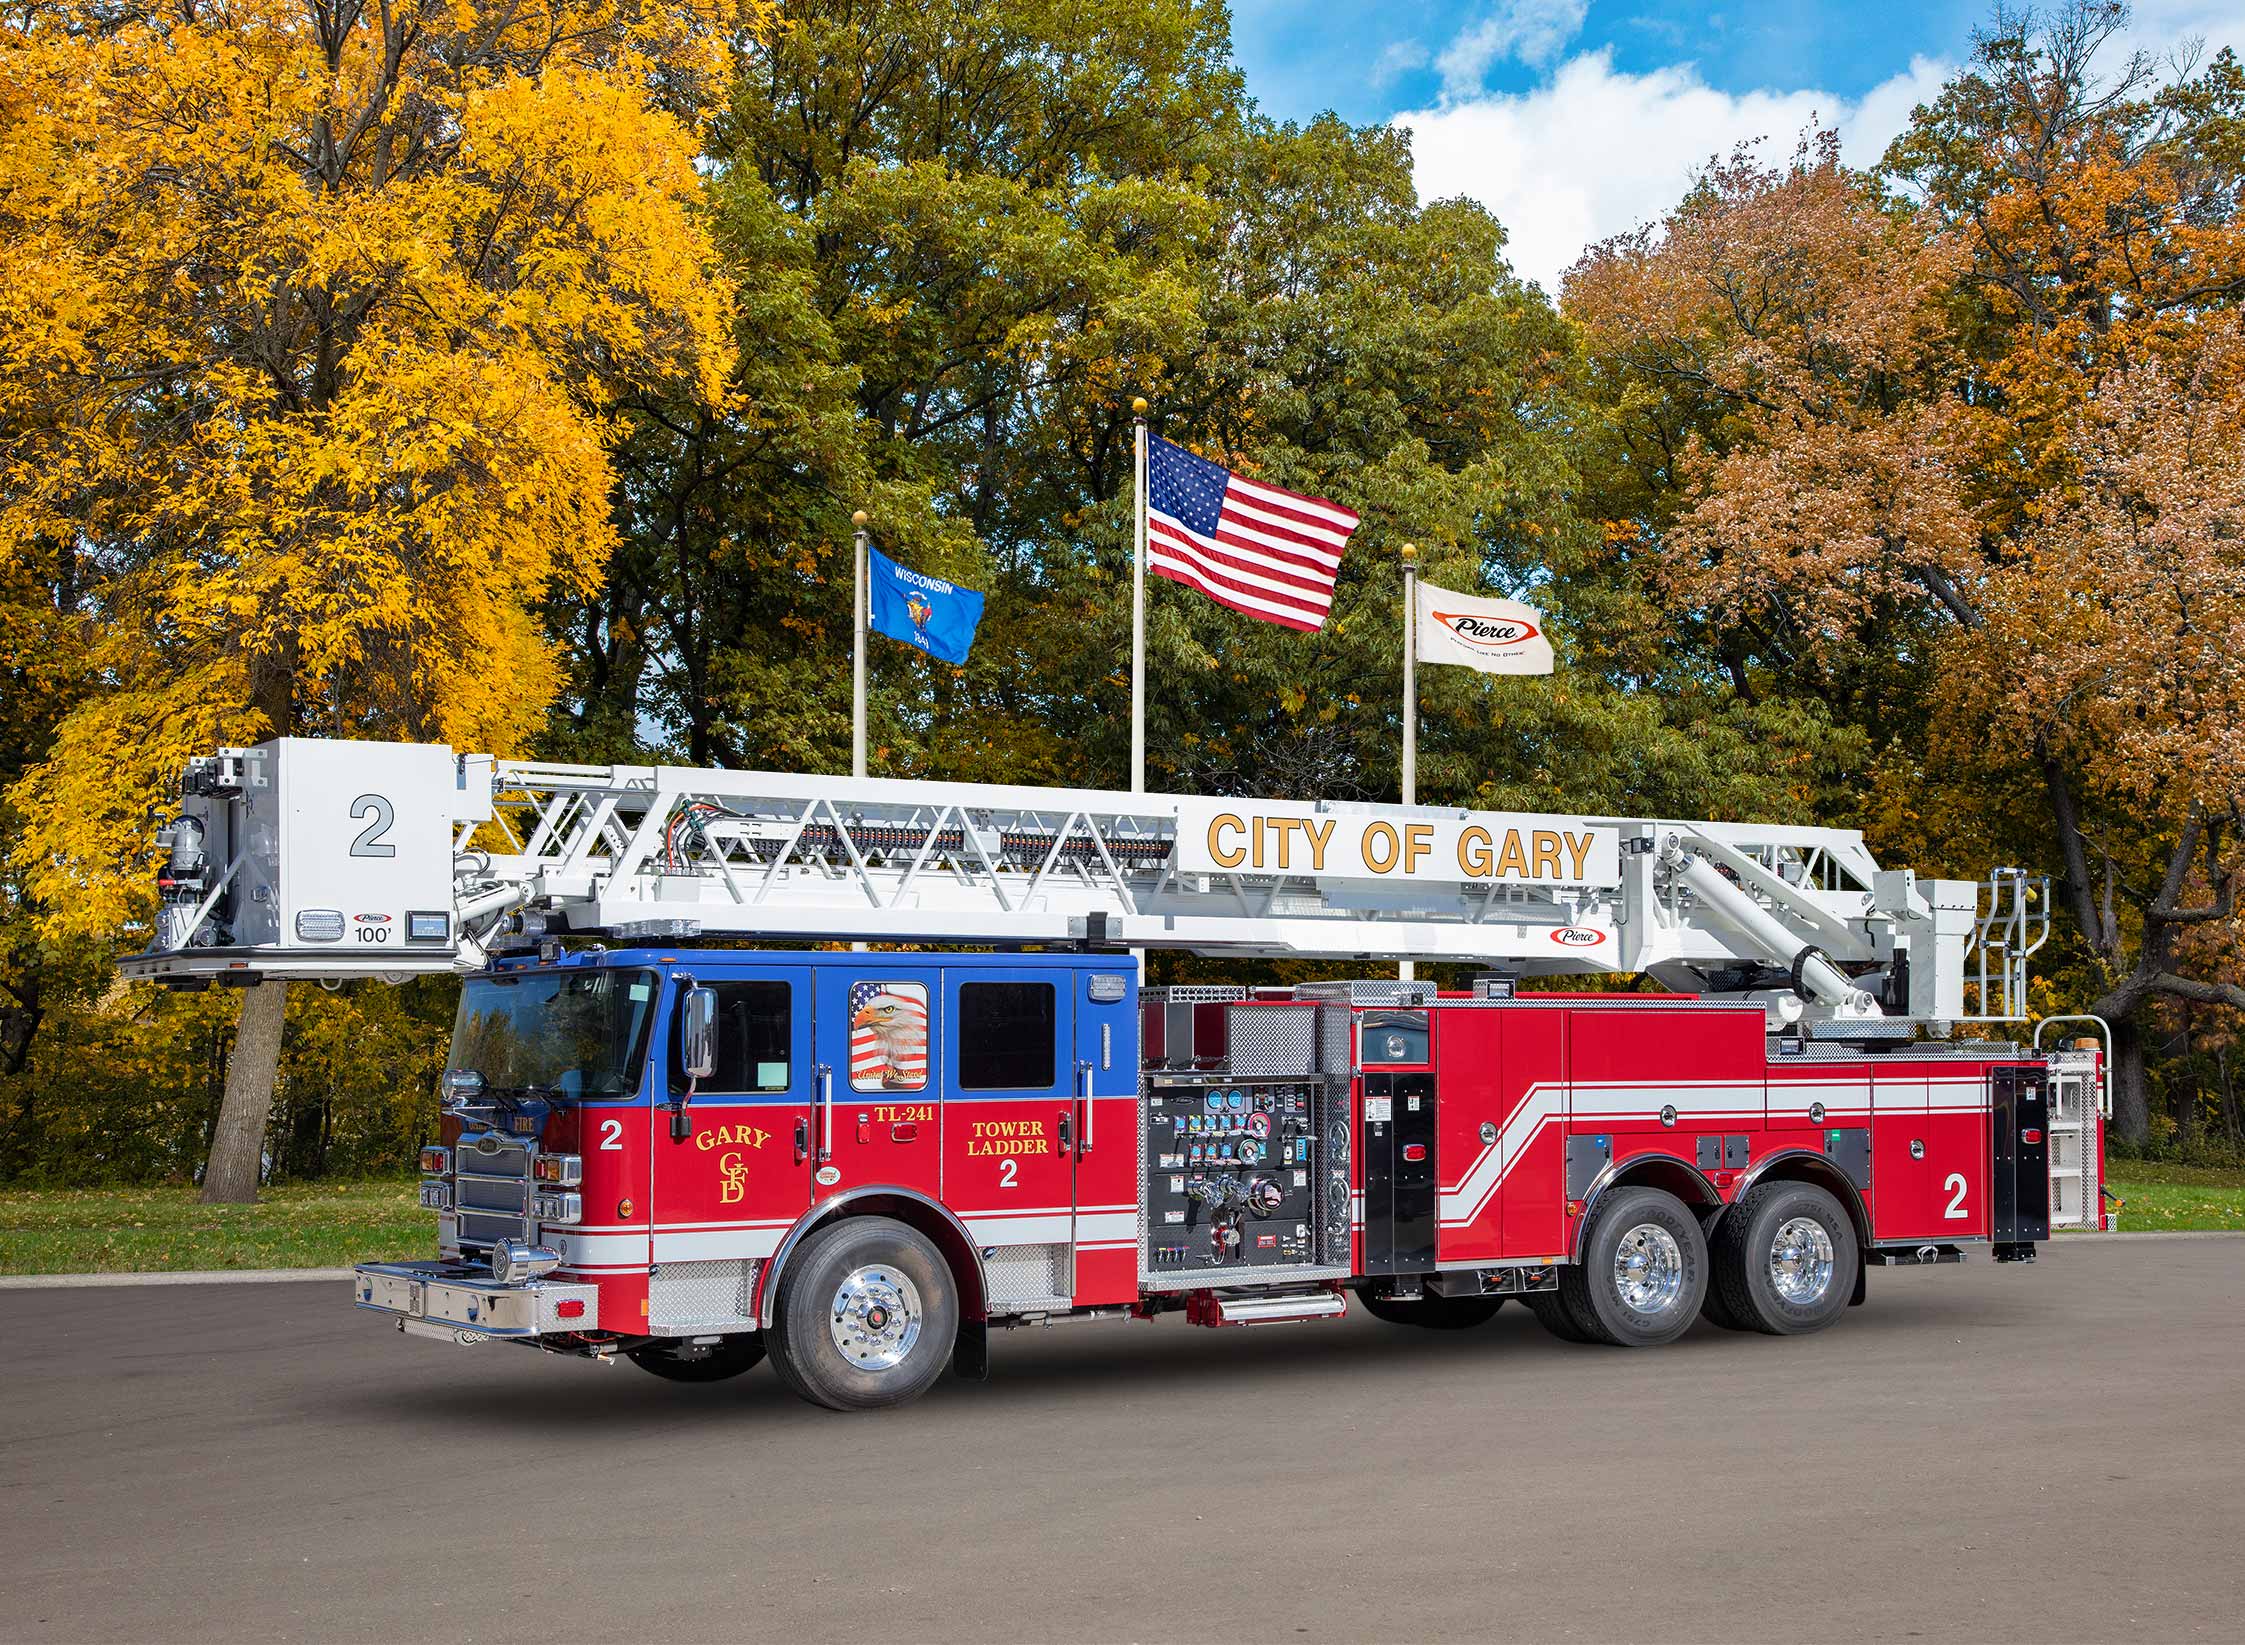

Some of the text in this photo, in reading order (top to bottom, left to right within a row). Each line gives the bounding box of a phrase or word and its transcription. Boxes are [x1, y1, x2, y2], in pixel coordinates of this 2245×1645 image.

[894, 565, 954, 595] WISCONSIN
[1455, 617, 1516, 639] Pierce
[350, 793, 396, 858] 2
[1207, 812, 1595, 881] CITY OF GARY
[1562, 929, 1594, 943] Pierce
[513, 1116, 535, 1133] FIRE
[874, 1105, 934, 1123] TL-241
[599, 1119, 623, 1151] 2
[695, 1124, 772, 1151] GARY
[972, 1121, 1045, 1137] TOWER
[967, 1139, 1049, 1156] LADDER
[999, 1158, 1018, 1188] 2
[1943, 1172, 1969, 1219] 2
